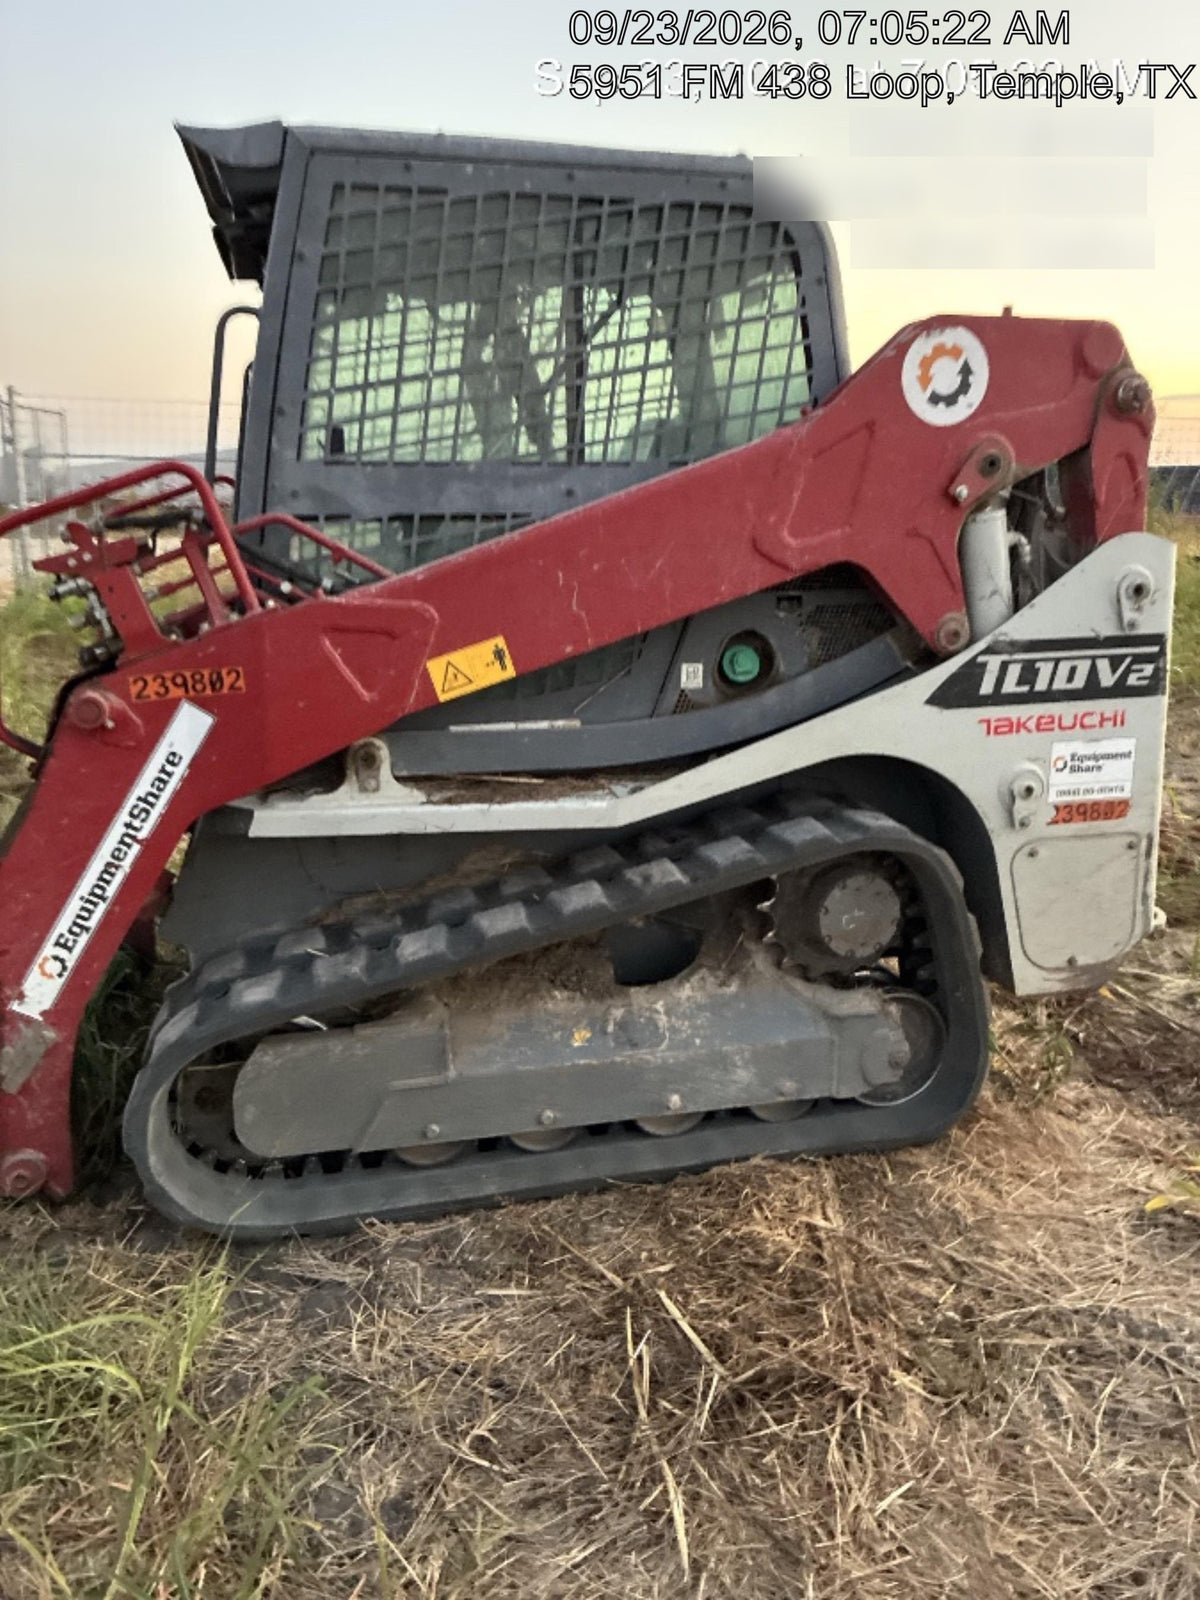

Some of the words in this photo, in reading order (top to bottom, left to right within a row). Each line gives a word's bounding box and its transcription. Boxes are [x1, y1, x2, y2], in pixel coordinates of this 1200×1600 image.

[132, 668, 243, 700] 239802
[976, 646, 1160, 696] TL10V2
[1069, 763, 1103, 774] Share
[1070, 749, 1133, 764] Equipment
[53, 748, 184, 957] EquipmentShare
